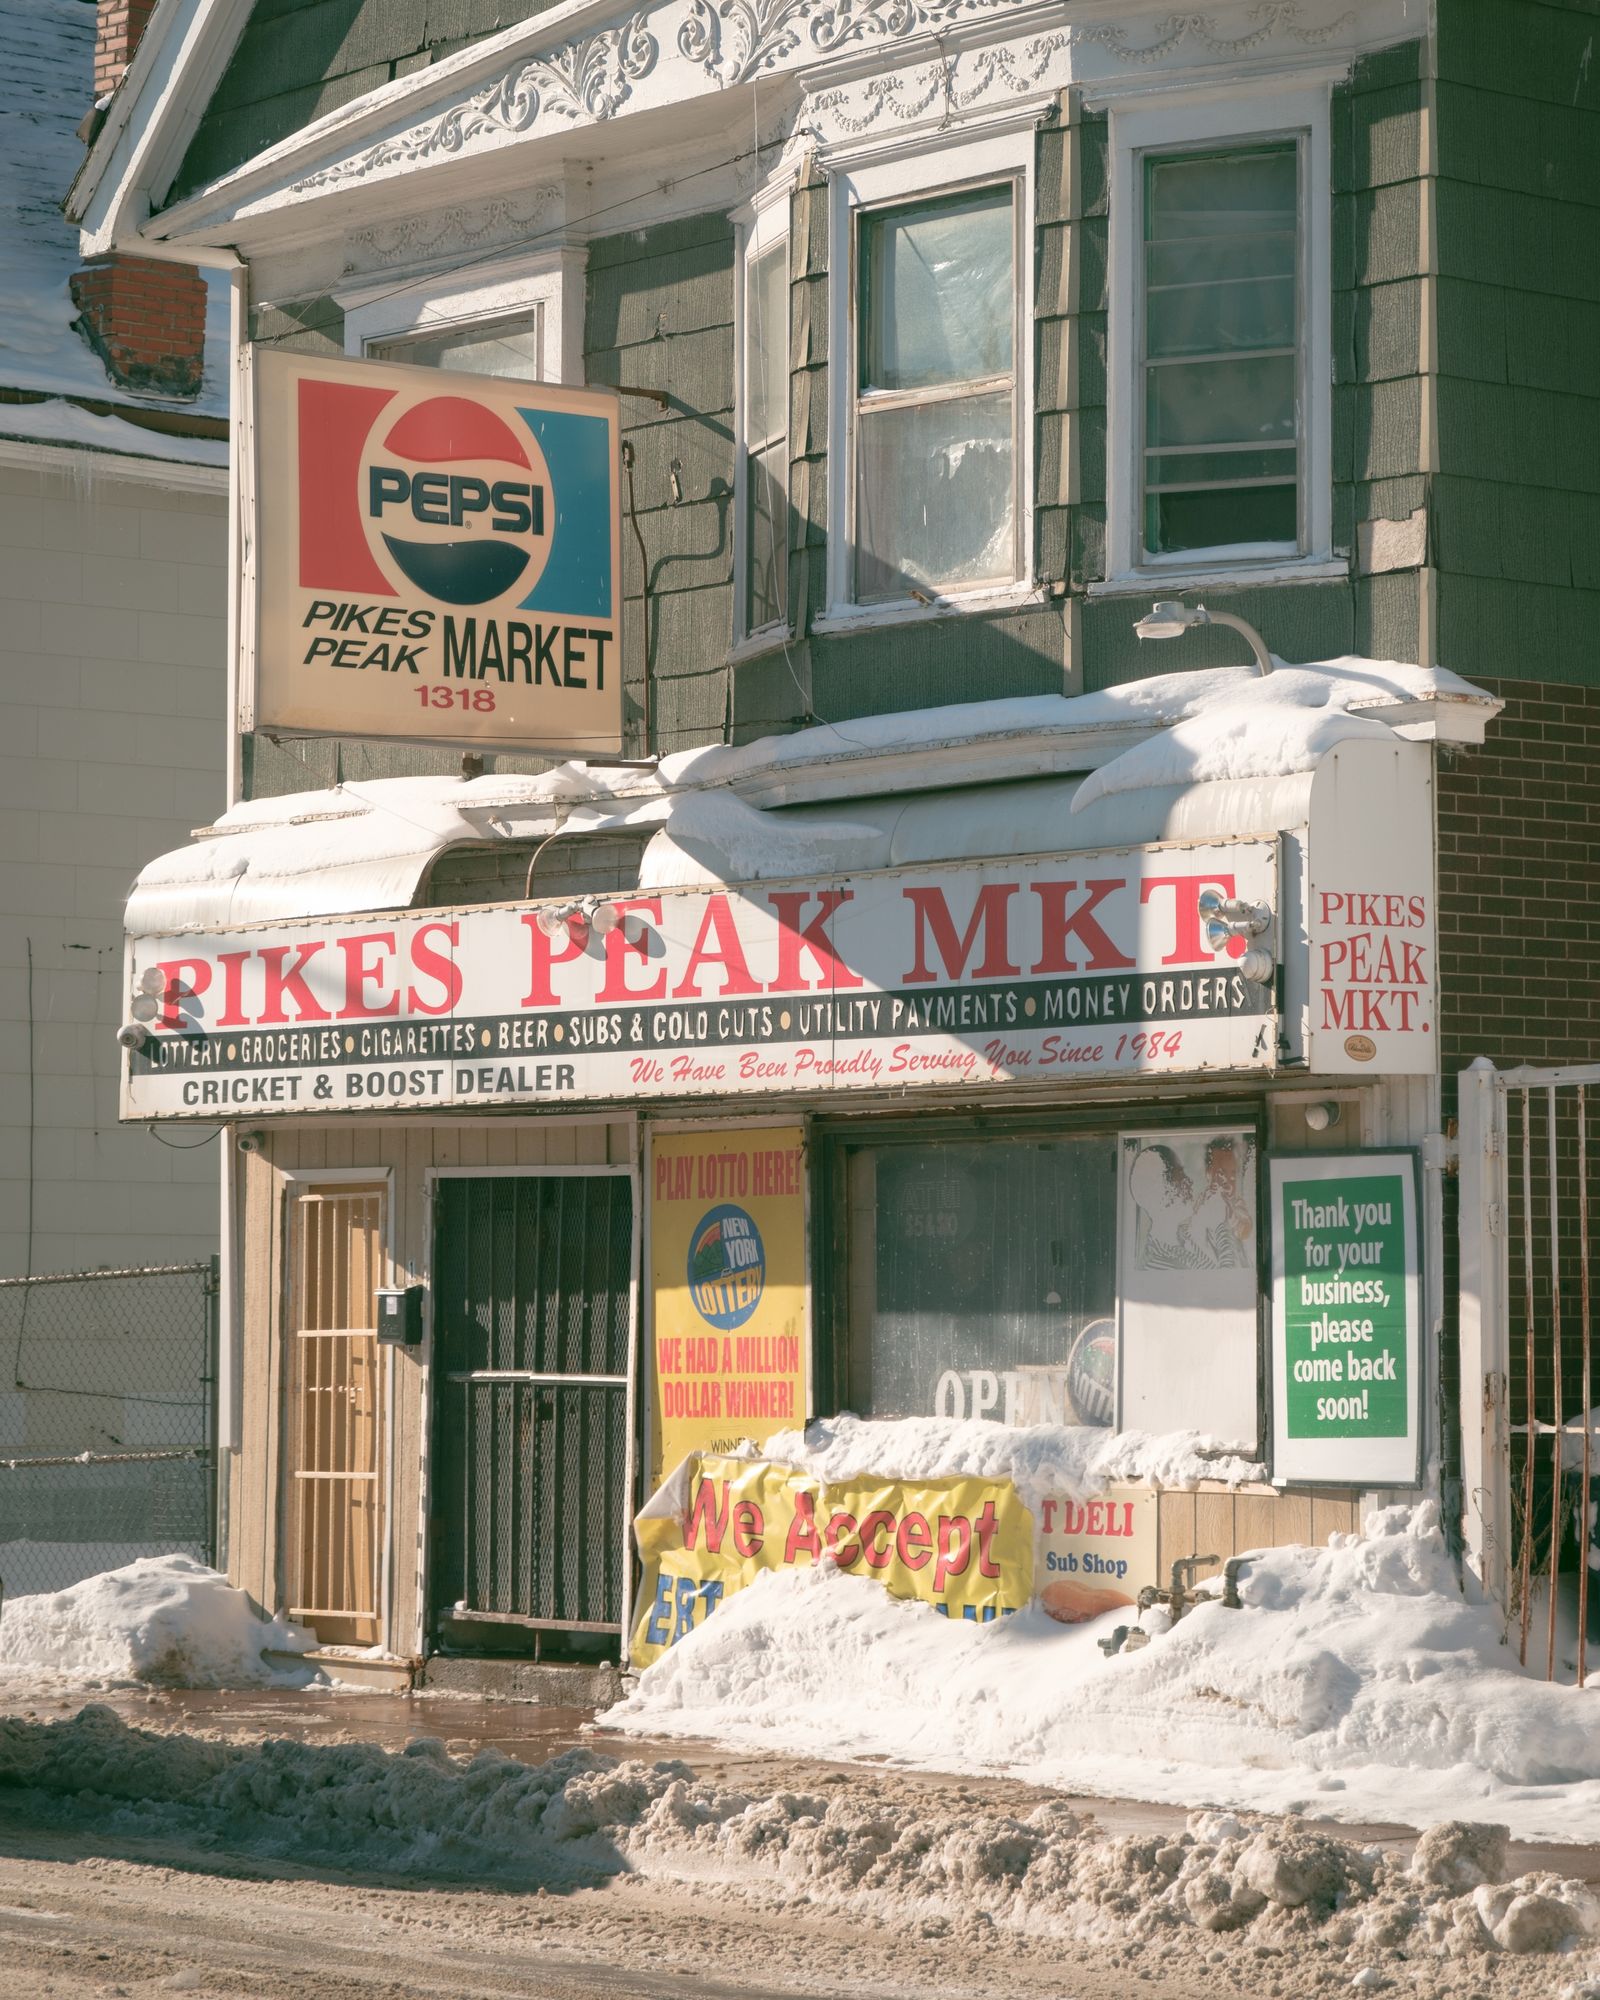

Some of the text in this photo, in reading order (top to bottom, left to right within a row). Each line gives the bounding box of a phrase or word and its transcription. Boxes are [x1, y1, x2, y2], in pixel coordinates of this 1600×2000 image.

[369, 466, 544, 536] PEPSI
[302, 601, 436, 639] PIKES
[303, 637, 429, 674] PEAK
[443, 615, 613, 691] MARKET
[413, 685, 496, 713] 1318
[1319, 892, 1426, 928] PIKES
[154, 873, 1248, 1031] PIKES PEAK MKT.
[1320, 932, 1428, 984] PEAK
[150, 975, 1246, 1069] LOTTERY GROCERIES CIGARETTES BEER SUBS & COLD CUTS UTILITY PAYMENTS MONEY ORDERS
[1320, 988, 1430, 1032] MKT.
[630, 1030, 1184, 1084] We Have Been Proudly Serving You Since 1984
[183, 1064, 575, 1106] CRICKET & BOOST DEALER
[656, 1149, 800, 1200] PLAY LOTTO HERE!
[722, 1217, 750, 1239] NEW
[1291, 1197, 1392, 1234] Thank you
[725, 1239, 760, 1269] YORK
[1304, 1237, 1384, 1274] for your
[694, 1264, 763, 1316] LOTTERY
[1301, 1274, 1390, 1308] business,
[1310, 1312, 1374, 1351] please
[659, 1336, 799, 1374] WE HAD A MILLION
[1293, 1349, 1397, 1382] come back
[664, 1381, 794, 1418] DOLLAR WINNER!
[935, 1369, 1068, 1427] OPEN
[1316, 1389, 1369, 1421] soon!
[681, 1478, 1001, 1592] We Accept
[1064, 1499, 1135, 1537] DELI
[1046, 1551, 1128, 1579] Sub Shop
